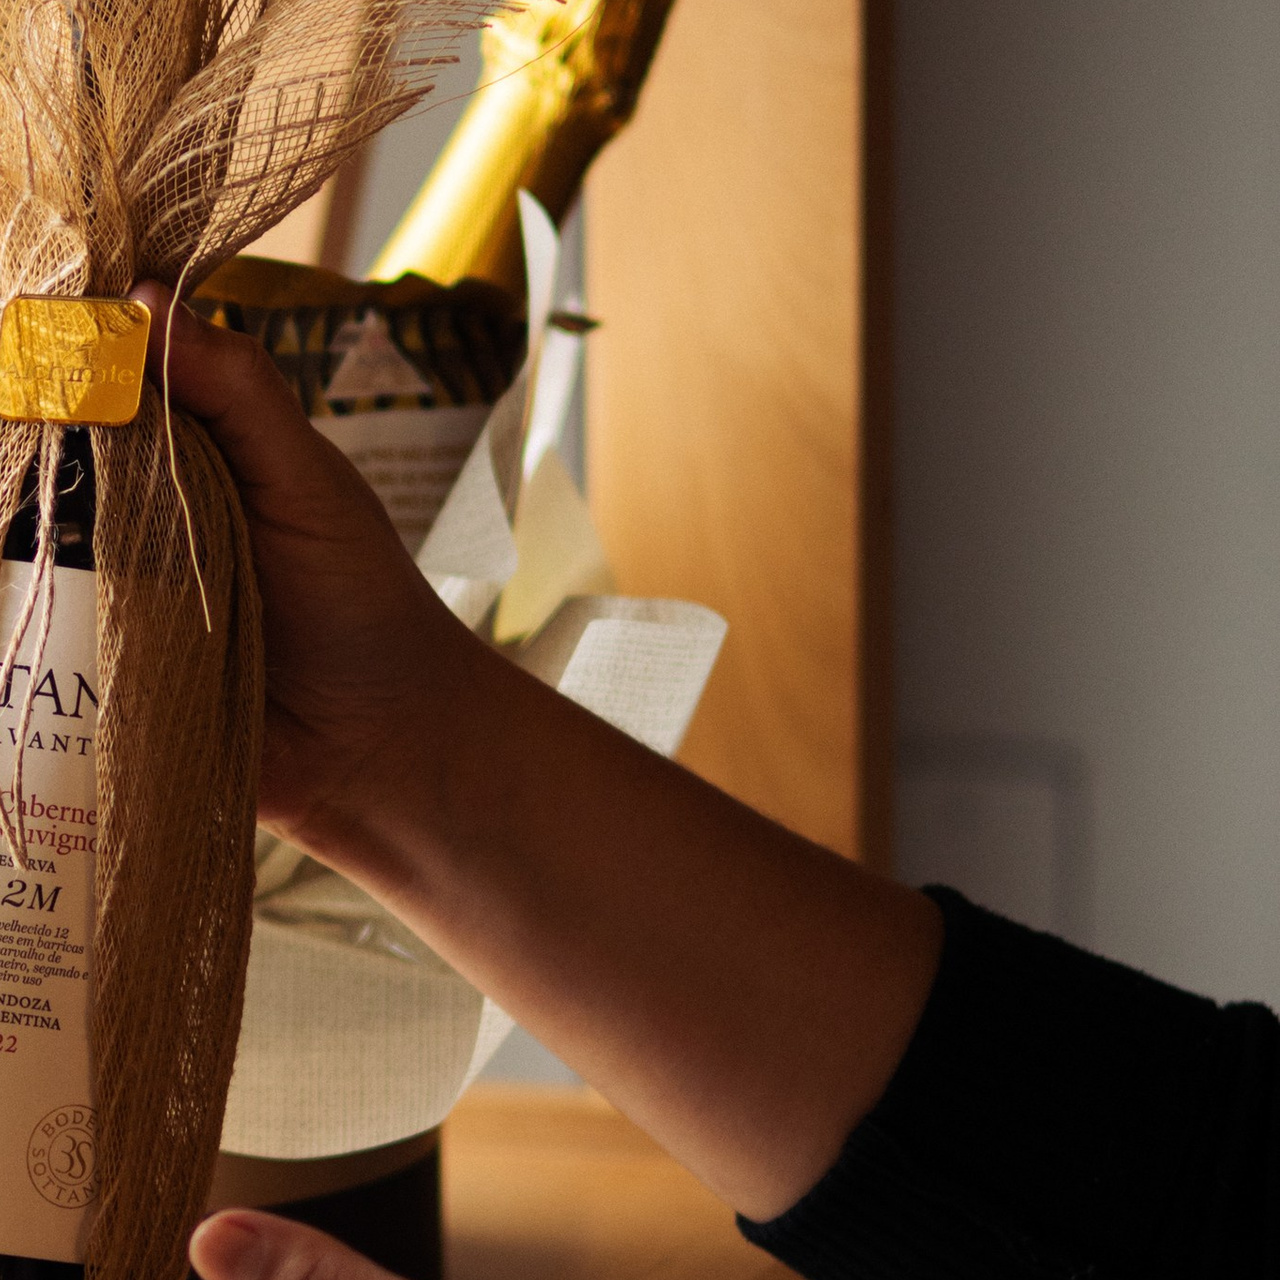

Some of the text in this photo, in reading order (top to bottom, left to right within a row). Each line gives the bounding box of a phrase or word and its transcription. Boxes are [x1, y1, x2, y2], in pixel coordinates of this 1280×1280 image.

[54, 927, 70, 939] 12
[16, 936, 34, 947] em
[37, 936, 85, 954] barricas
[47, 951, 62, 964] de
[32, 965, 80, 980] segundo
[82, 971, 89, 980] e
[22, 977, 43, 987] uso
